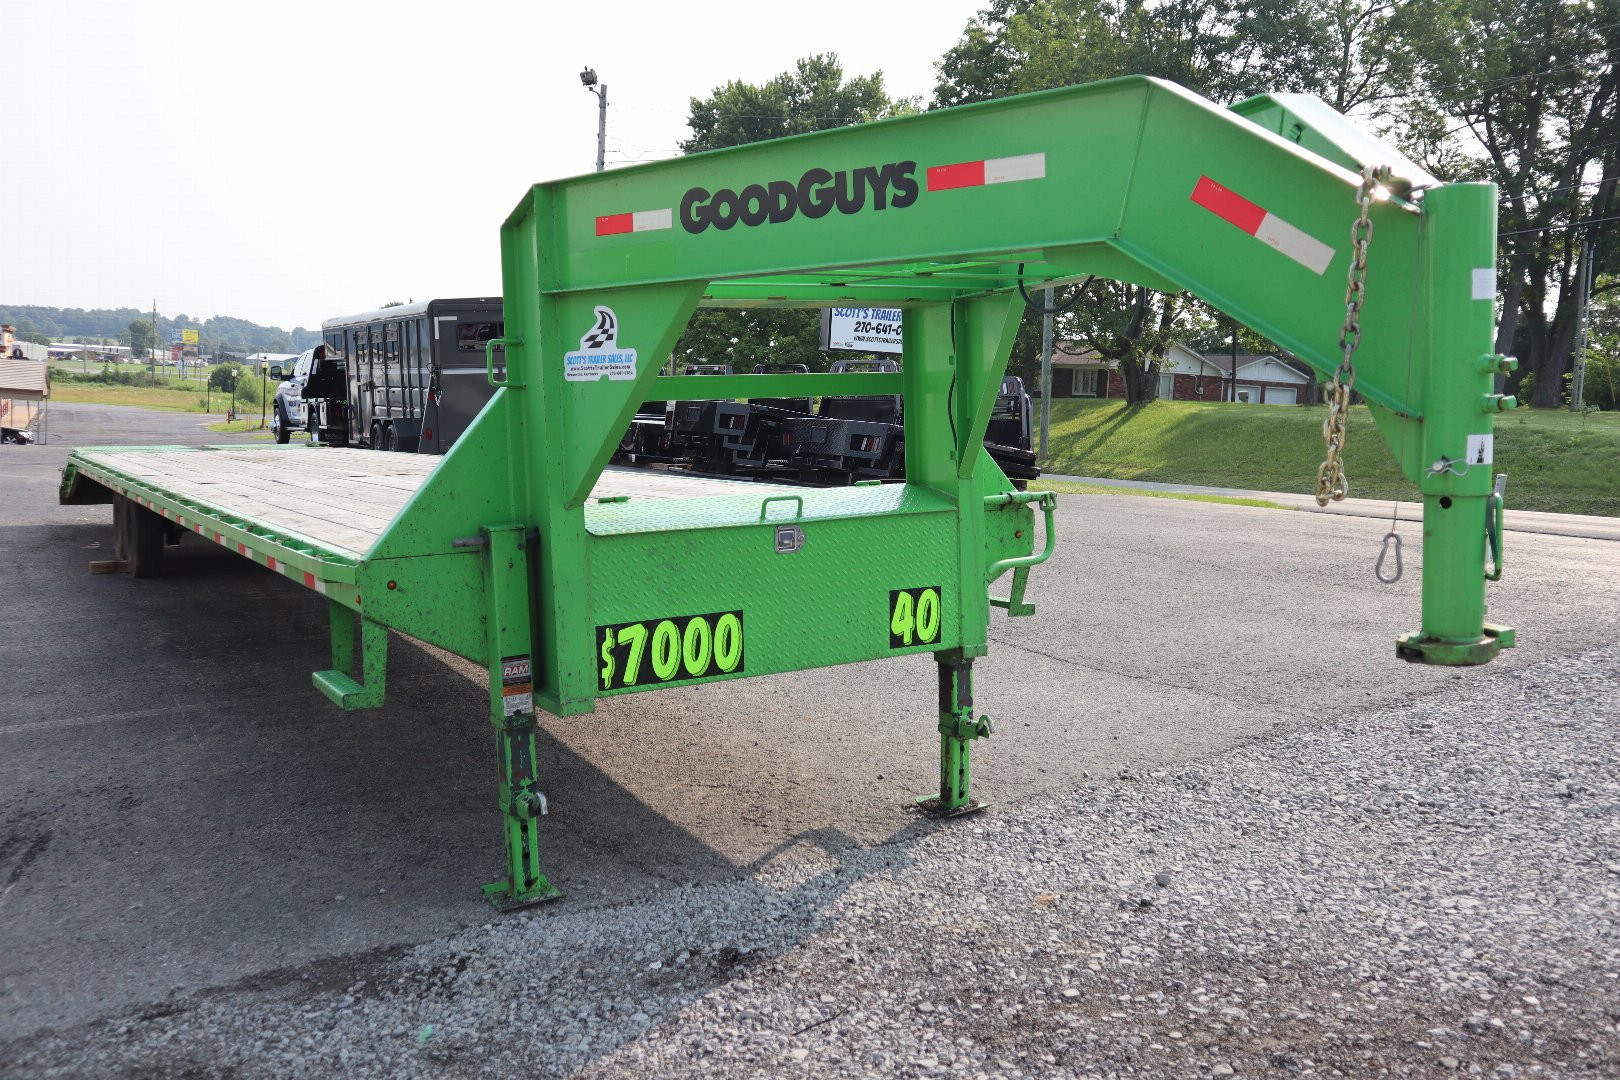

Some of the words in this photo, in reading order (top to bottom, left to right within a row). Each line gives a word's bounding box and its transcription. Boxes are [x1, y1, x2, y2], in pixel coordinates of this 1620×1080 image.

[680, 160, 919, 234] GOODGUYS
[834, 308, 870, 319] SCOTT'S
[871, 309, 902, 321] TRAILER
[567, 356, 586, 365] SCOTT'S
[588, 354, 606, 364] TRAILER
[608, 354, 624, 364] SALES,
[625, 354, 634, 362] LLC
[891, 588, 941, 646] 40
[601, 613, 743, 690] $7000
[504, 664, 529, 677] RAM
